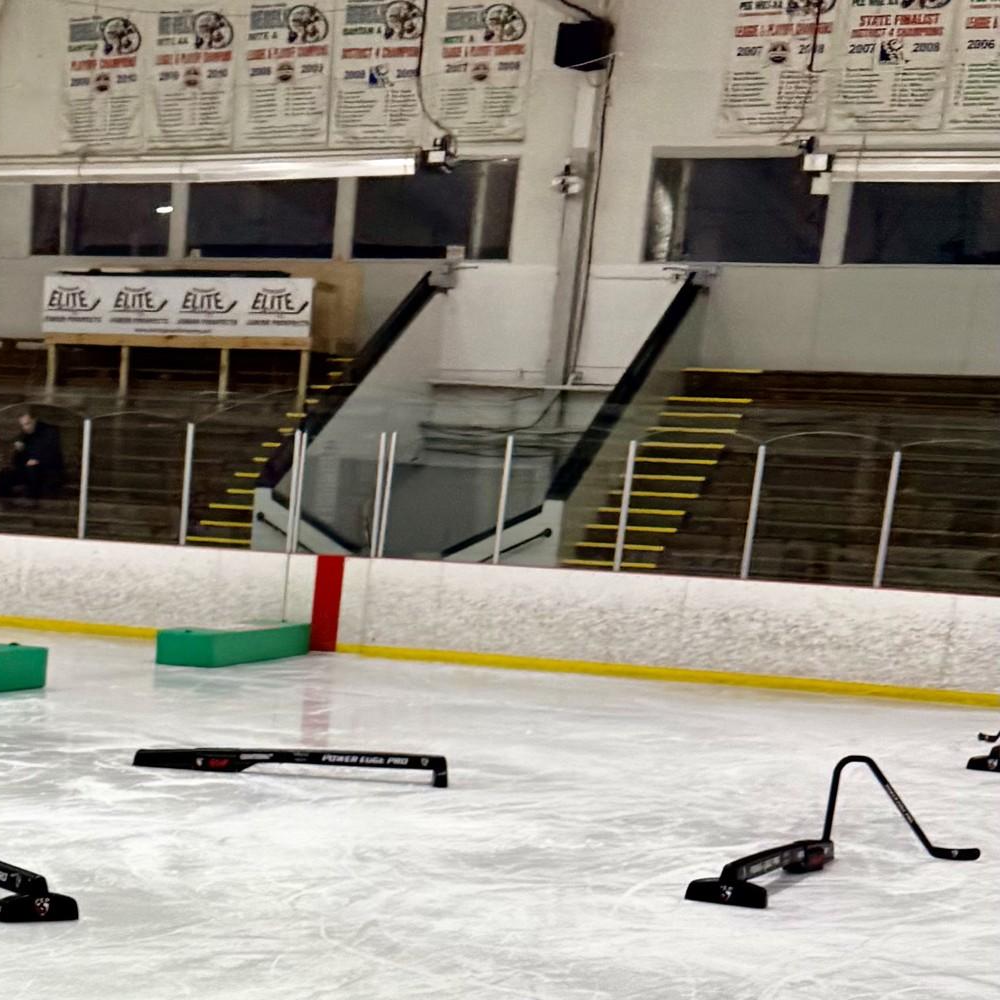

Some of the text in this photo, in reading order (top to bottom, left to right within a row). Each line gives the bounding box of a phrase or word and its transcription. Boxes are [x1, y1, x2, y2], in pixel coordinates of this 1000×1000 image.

[860, 13, 941, 26] STATE FINALIST
[848, 43, 876, 54] 2007
[48, 289, 89, 308] ELITE
[113, 291, 155, 309] ELITE
[181, 291, 225, 310] ELITE
[251, 292, 295, 311] ELITE
